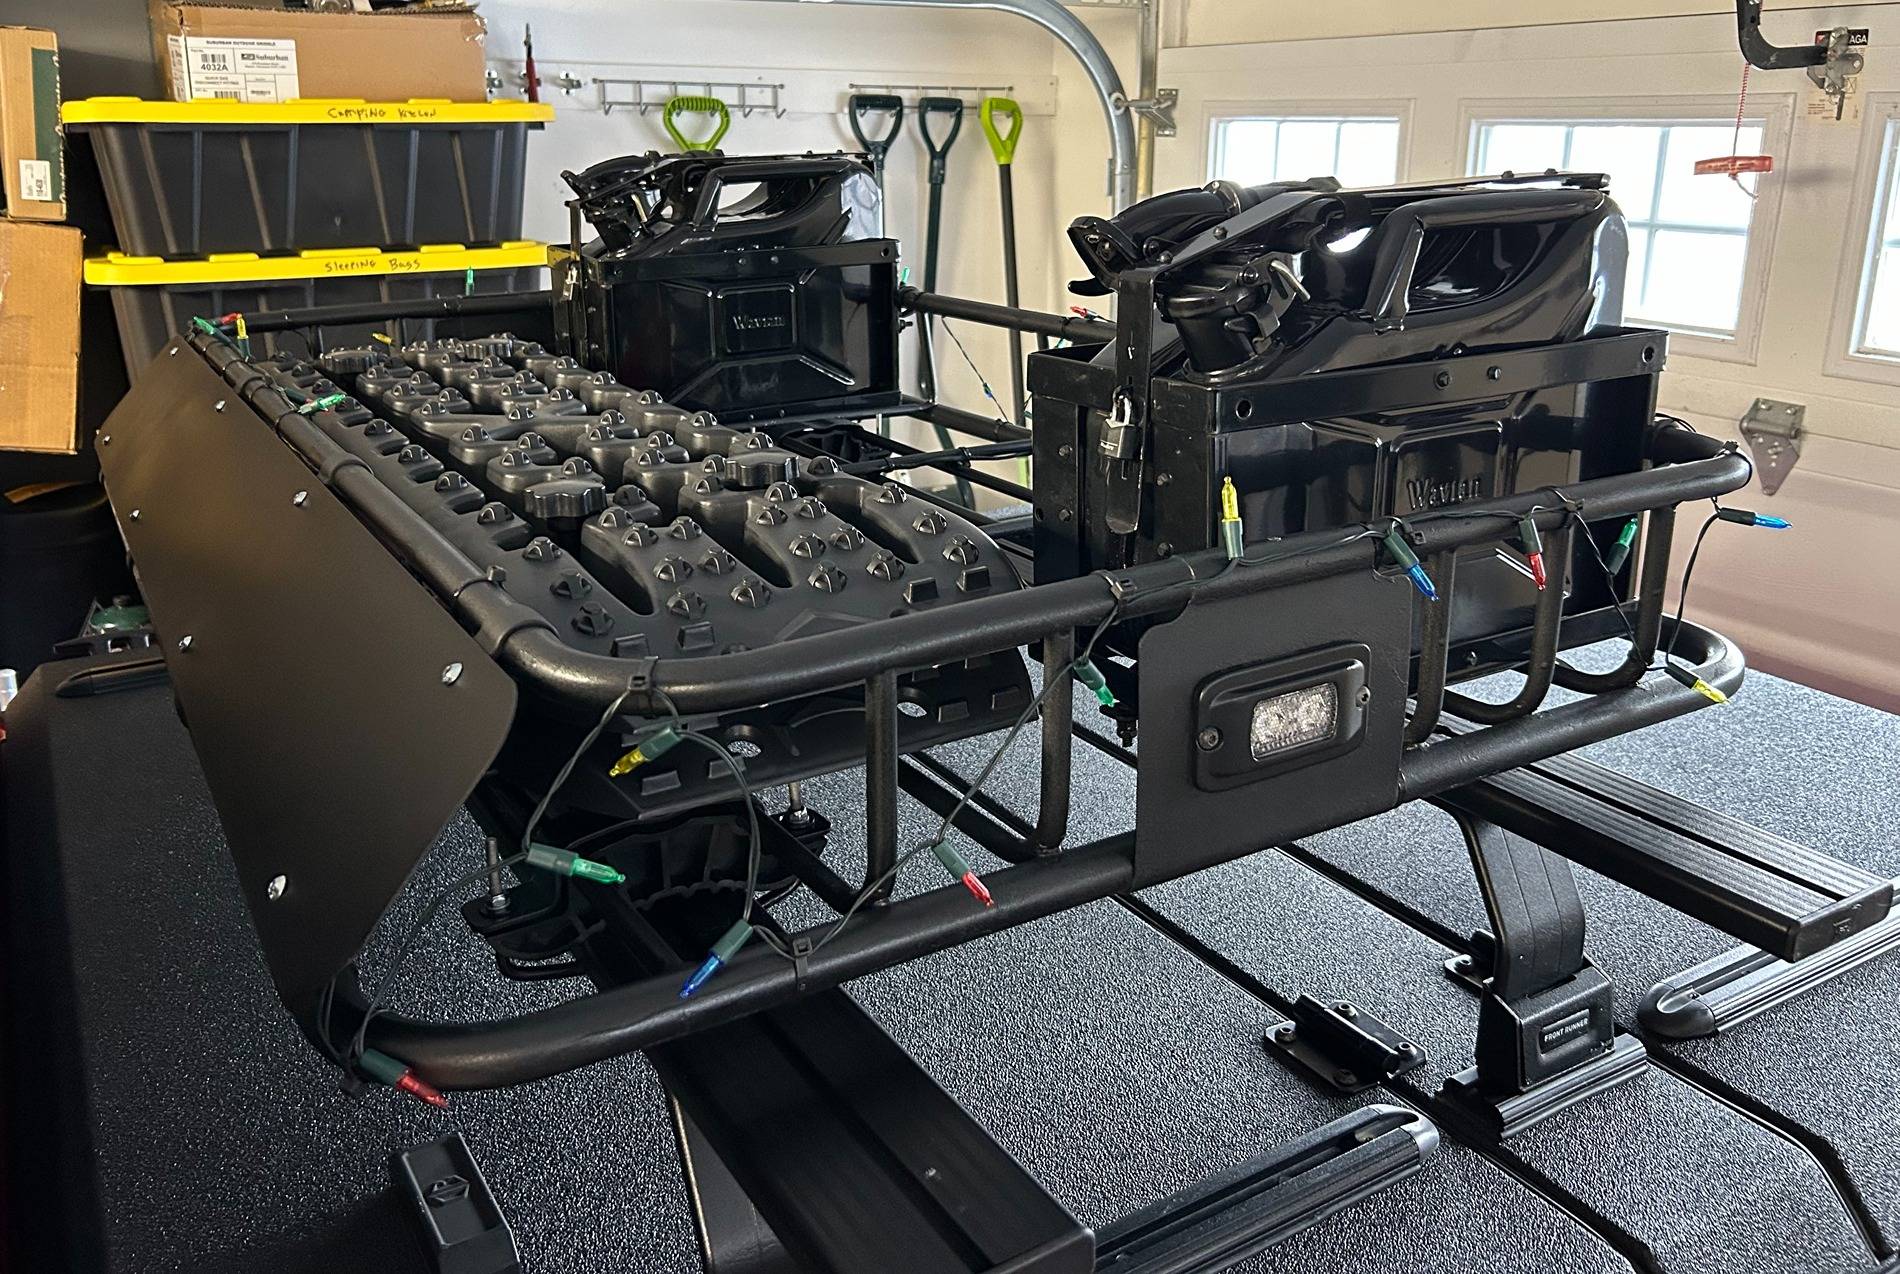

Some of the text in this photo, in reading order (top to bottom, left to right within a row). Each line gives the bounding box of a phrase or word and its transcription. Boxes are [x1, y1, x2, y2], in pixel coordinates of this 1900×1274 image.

[255, 53, 289, 61] Suburban
[733, 315, 785, 330] Wavian
[1408, 478, 1480, 511] Wavian
[1544, 1018, 1588, 1042] FRONT RUNNER
